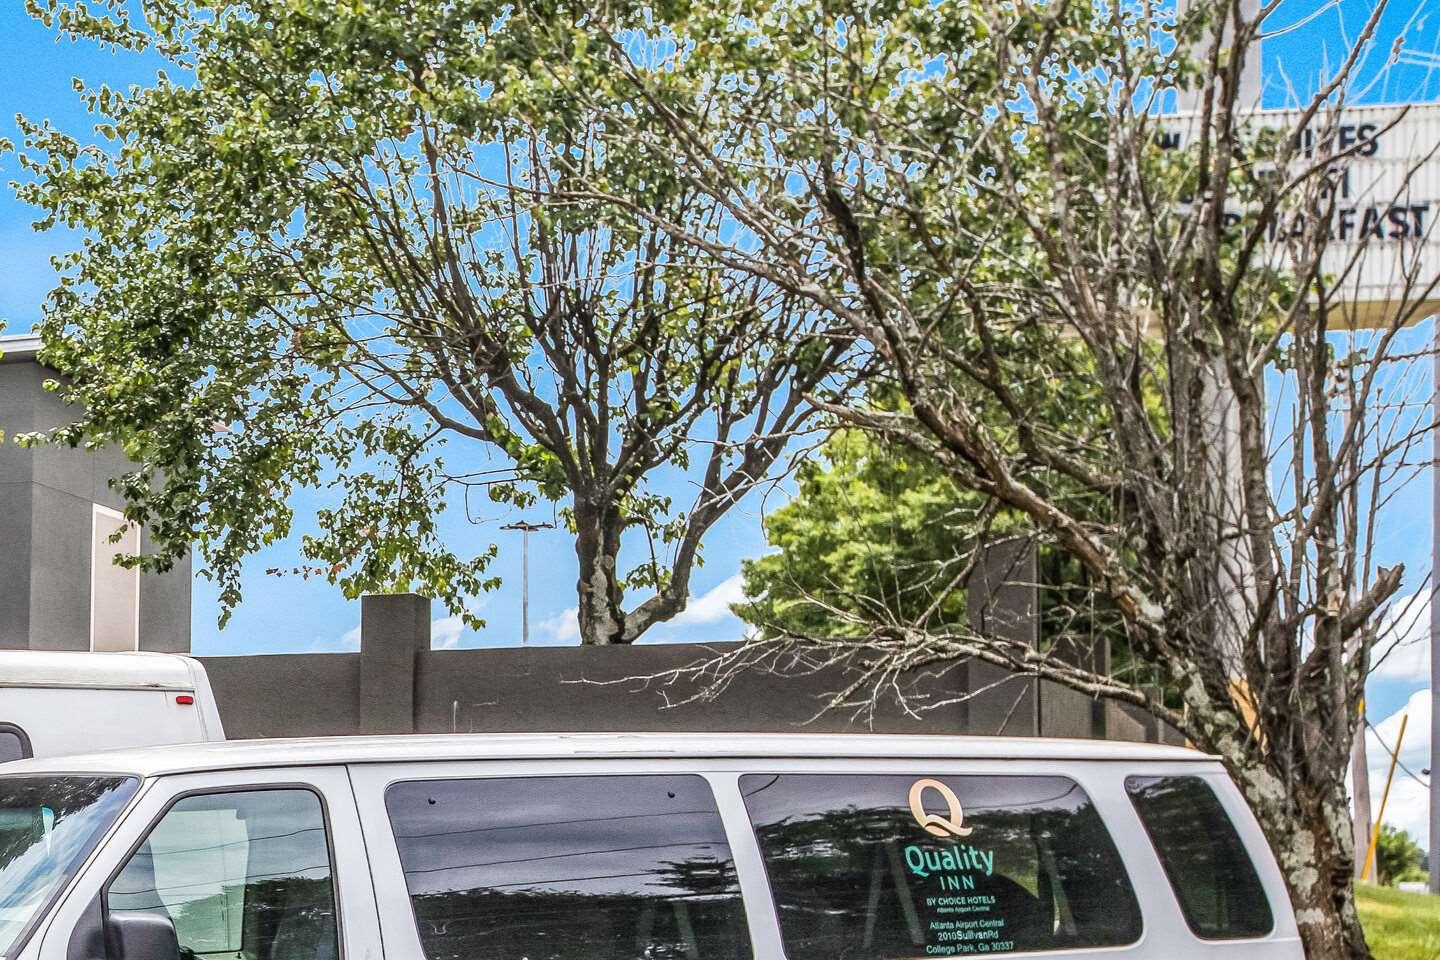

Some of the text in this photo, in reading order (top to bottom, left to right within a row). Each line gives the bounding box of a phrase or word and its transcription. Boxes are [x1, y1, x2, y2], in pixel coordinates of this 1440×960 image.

[909, 778, 973, 837] Q
[905, 845, 994, 877] Quality
[940, 876, 975, 890] INN
[926, 895, 996, 906] BY CHOICE HOTELS
[929, 918, 1004, 930] Atlanta Airport Central
[926, 944, 956, 954] College
[977, 942, 990, 951] Ga
[990, 940, 1014, 951] 30337
